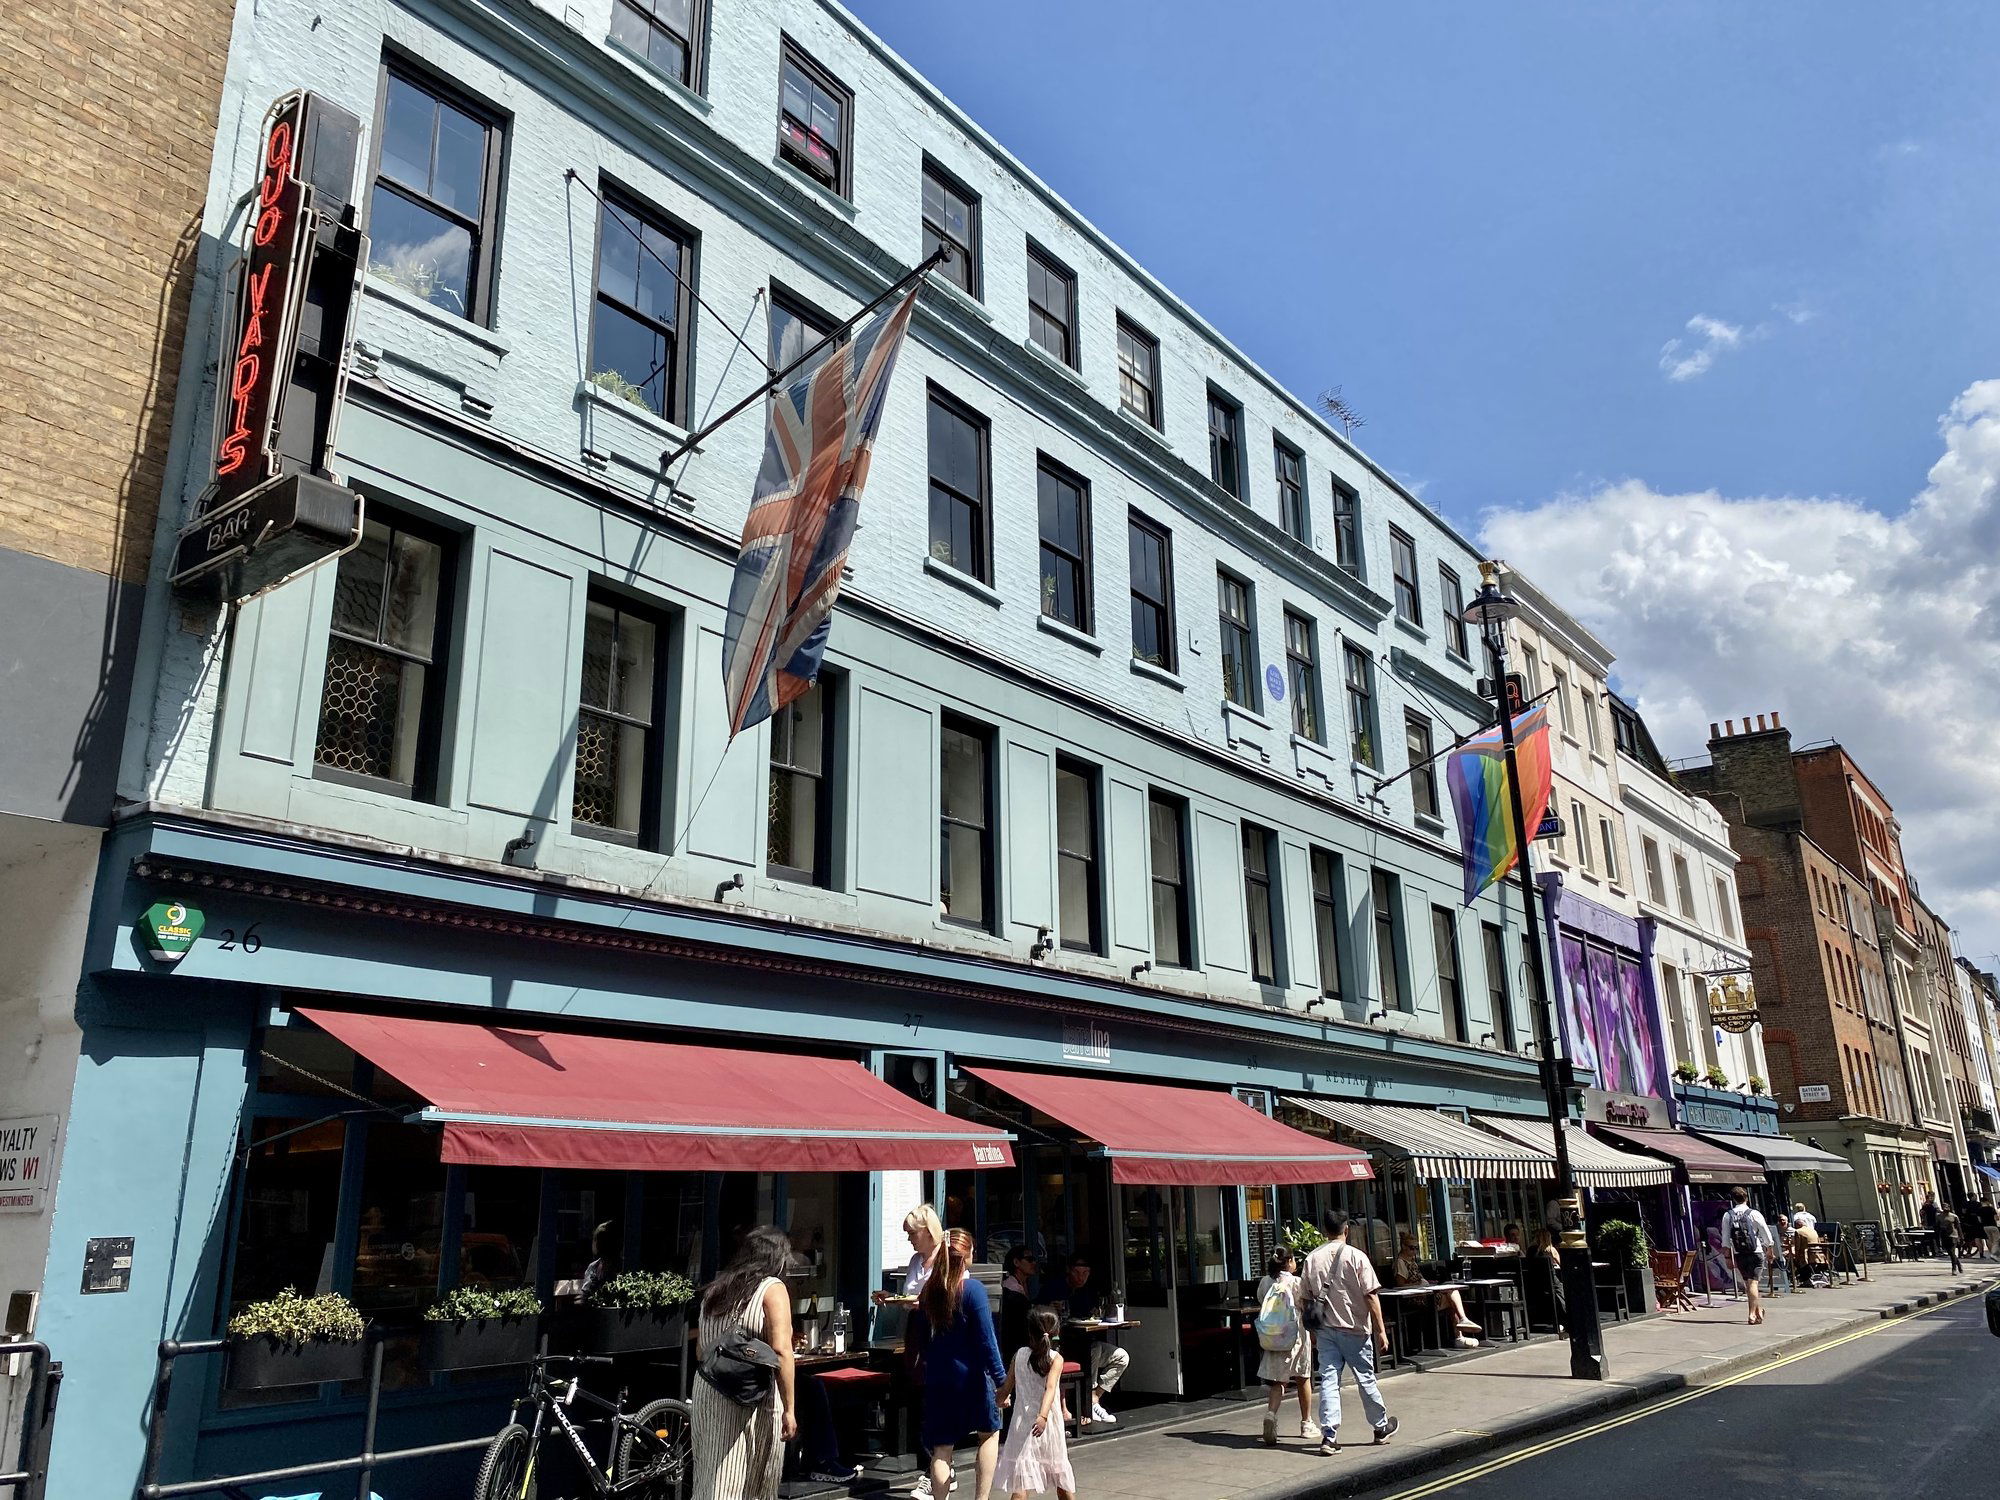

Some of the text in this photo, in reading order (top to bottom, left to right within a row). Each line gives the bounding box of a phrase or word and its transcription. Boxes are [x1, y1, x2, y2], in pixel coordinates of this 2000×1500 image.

[218, 121, 291, 475] QUO VADIS
[207, 508, 250, 551] BAR
[158, 925, 192, 935] CLASSIC
[217, 922, 263, 954] 26
[903, 1012, 924, 1037] 27
[1324, 1068, 1394, 1090] RESTAURANT
[0, 1127, 38, 1152] YALTY
[23, 1156, 40, 1180] W1
[552, 1402, 597, 1468] ROCKRIDER
